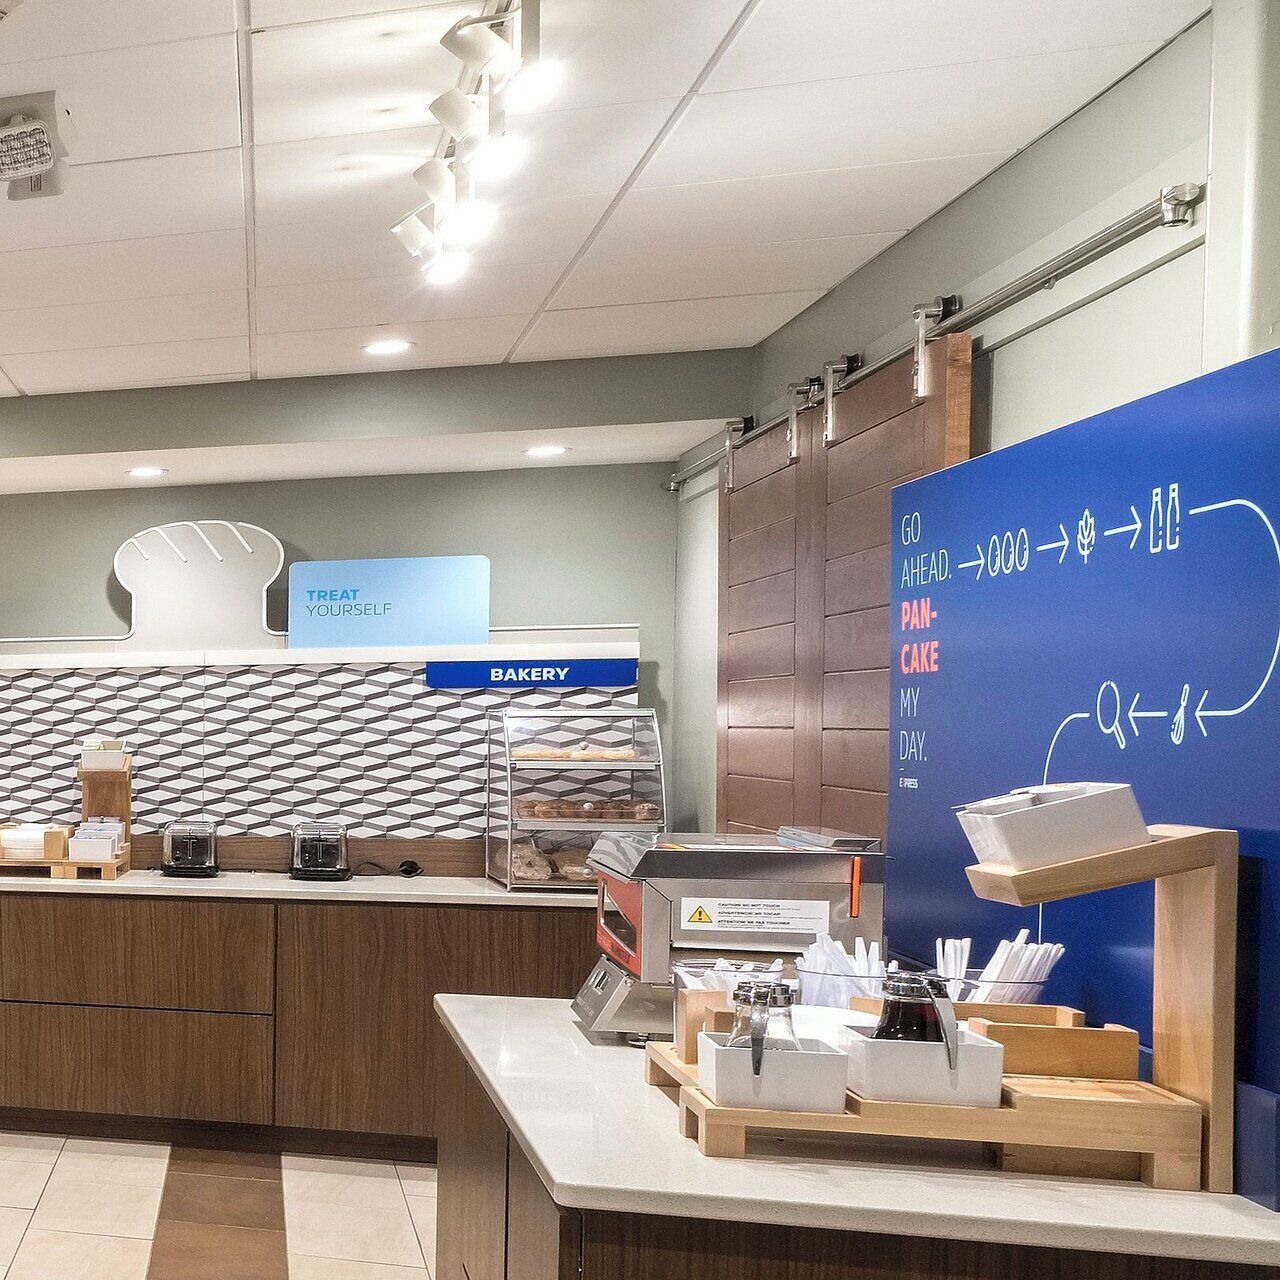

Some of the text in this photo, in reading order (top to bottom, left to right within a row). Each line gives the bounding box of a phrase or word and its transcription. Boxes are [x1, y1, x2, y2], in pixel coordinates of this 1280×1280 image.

[900, 512, 921, 546] GO
[900, 548, 952, 589] AHEAD.
[305, 602, 392, 617] YOURSELF
[306, 588, 360, 601] TREAT
[901, 597, 937, 631] PAN-
[900, 641, 939, 674] CAKE
[490, 667, 570, 682] BAKERY
[900, 687, 920, 718] MY
[899, 731, 928, 762] DAY.
[899, 777, 919, 789] EPRESS
